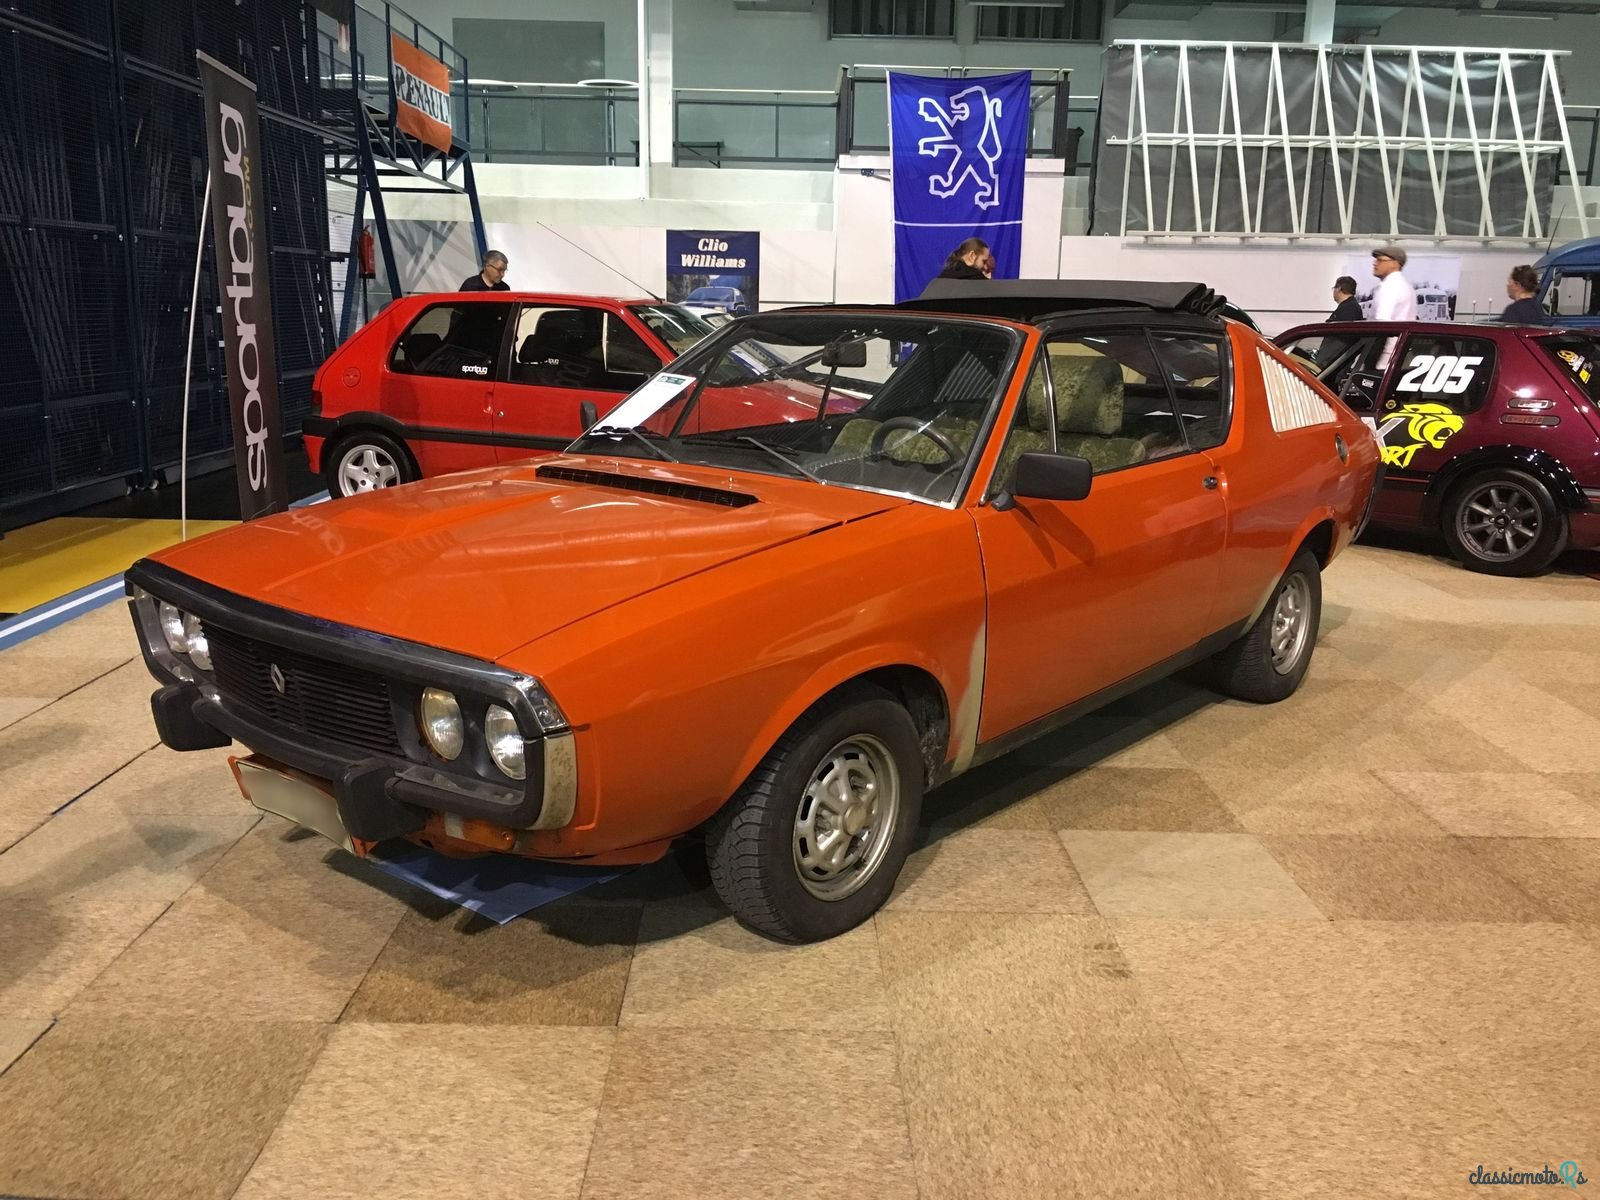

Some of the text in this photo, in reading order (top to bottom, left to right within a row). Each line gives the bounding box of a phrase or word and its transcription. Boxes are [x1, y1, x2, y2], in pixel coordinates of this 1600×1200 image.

[698, 238, 728, 252] Clio
[681, 254, 746, 268] Williams
[219, 102, 268, 492] sportpug
[461, 365, 488, 375] sportpug
[1396, 355, 1484, 394] 205
